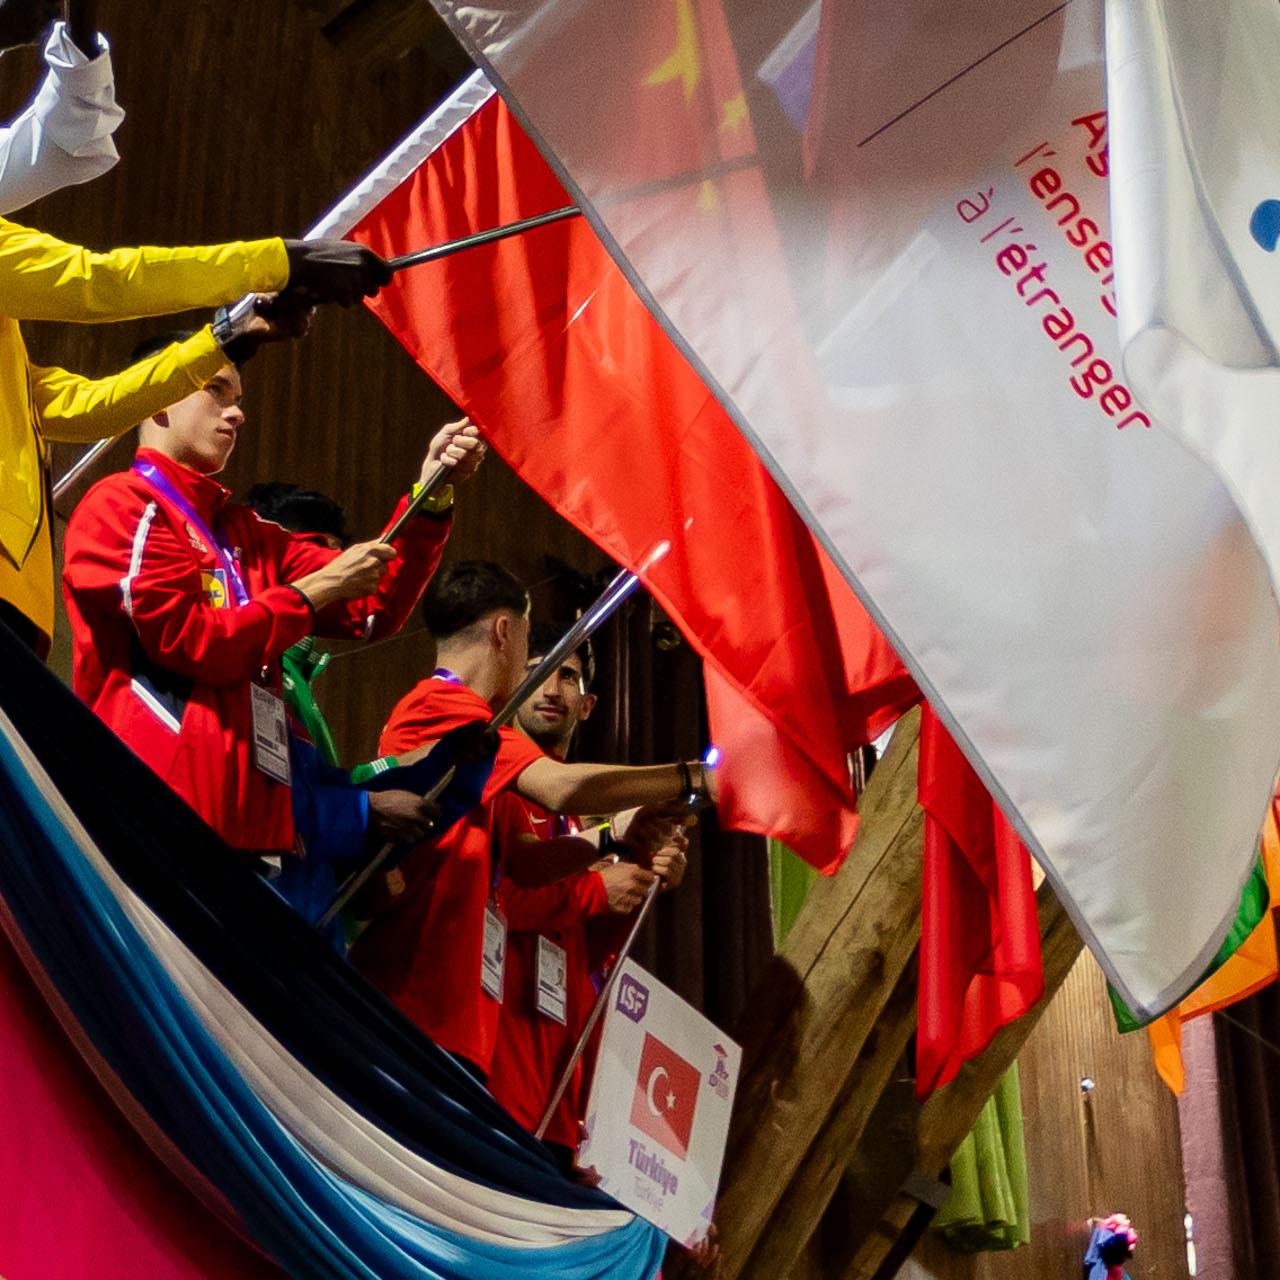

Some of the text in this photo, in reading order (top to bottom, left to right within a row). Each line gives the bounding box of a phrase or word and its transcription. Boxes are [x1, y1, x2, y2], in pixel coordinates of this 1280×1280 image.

[956, 188, 1151, 430] à l'étranger
[620, 982, 647, 1015] ISF
[627, 1138, 678, 1196] Türkiye
